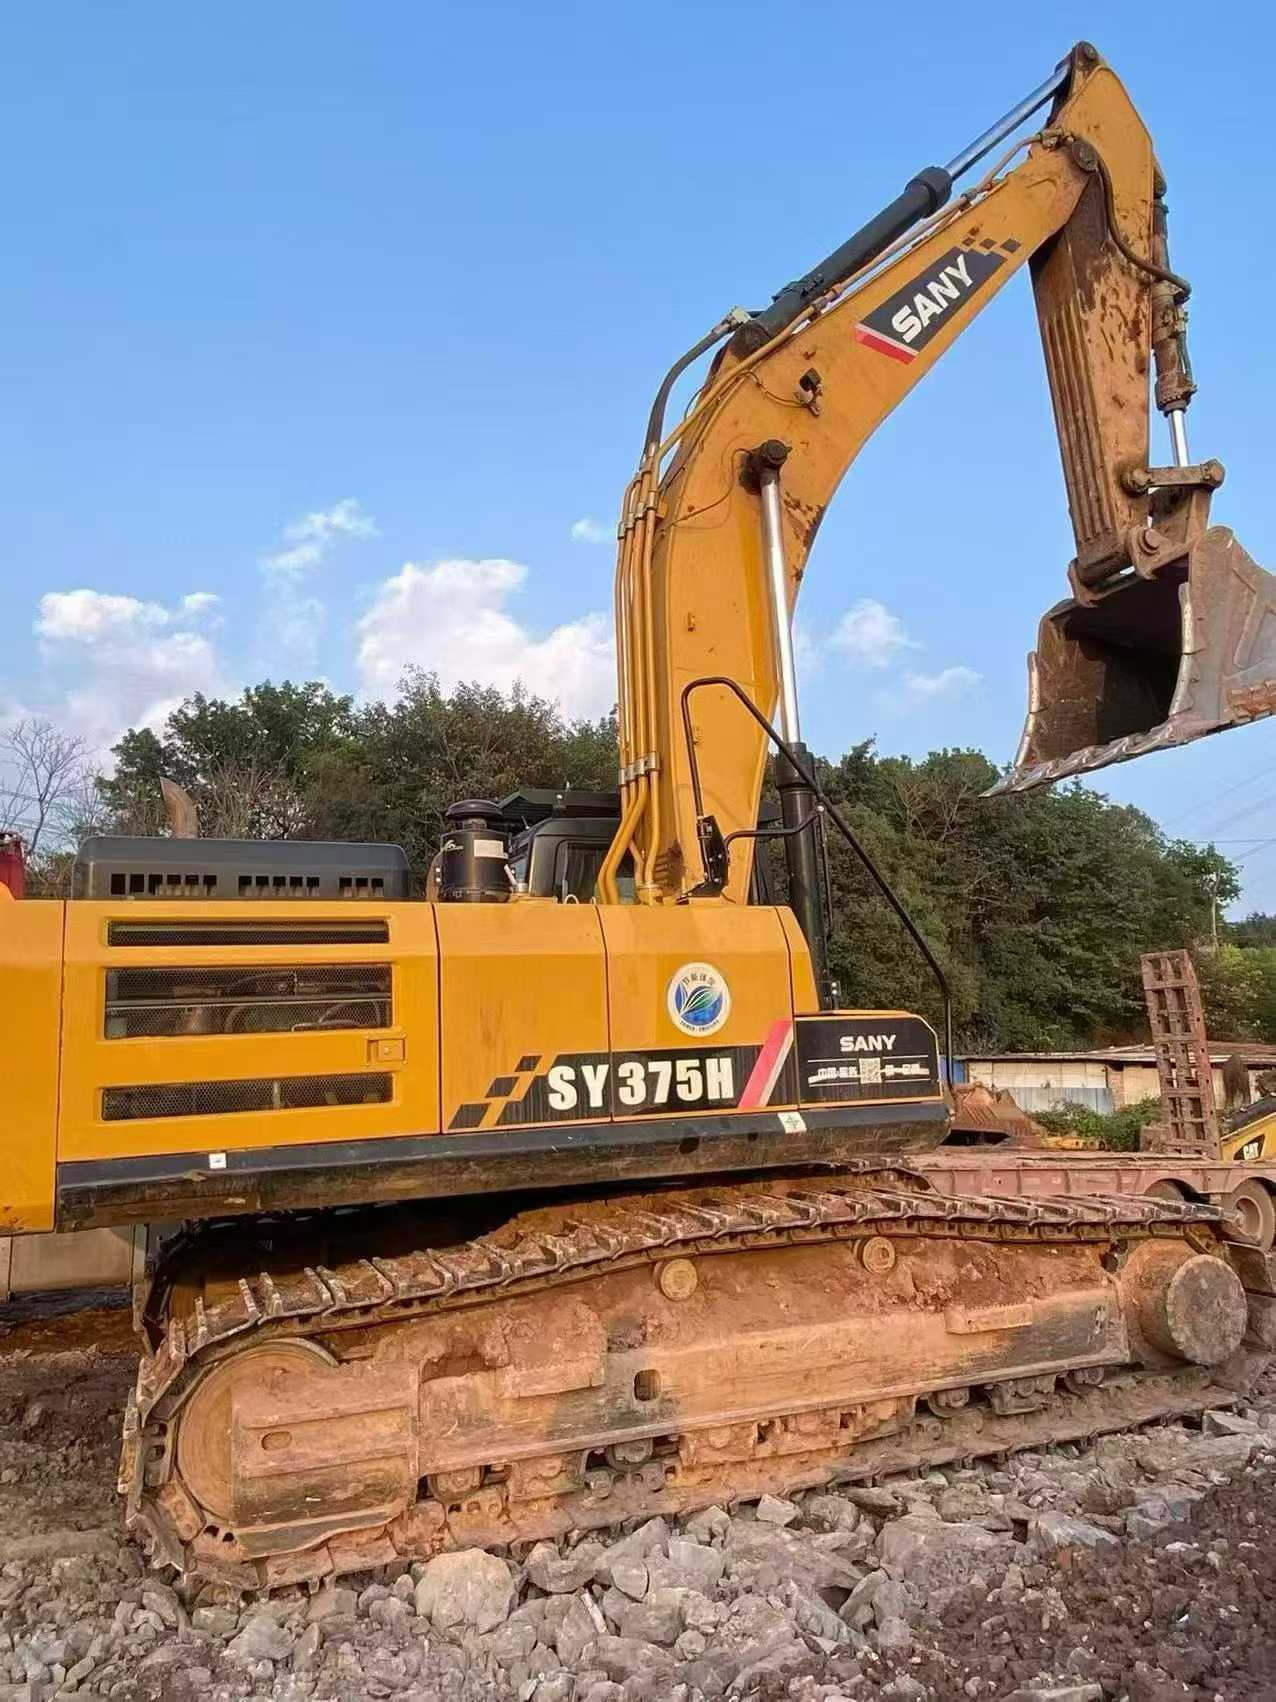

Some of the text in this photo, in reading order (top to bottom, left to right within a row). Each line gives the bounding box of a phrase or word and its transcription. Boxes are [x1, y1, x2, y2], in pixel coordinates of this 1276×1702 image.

[892, 254, 973, 344] SANY
[840, 1034, 897, 1052] SANY
[1243, 1142, 1260, 1160] CAT
